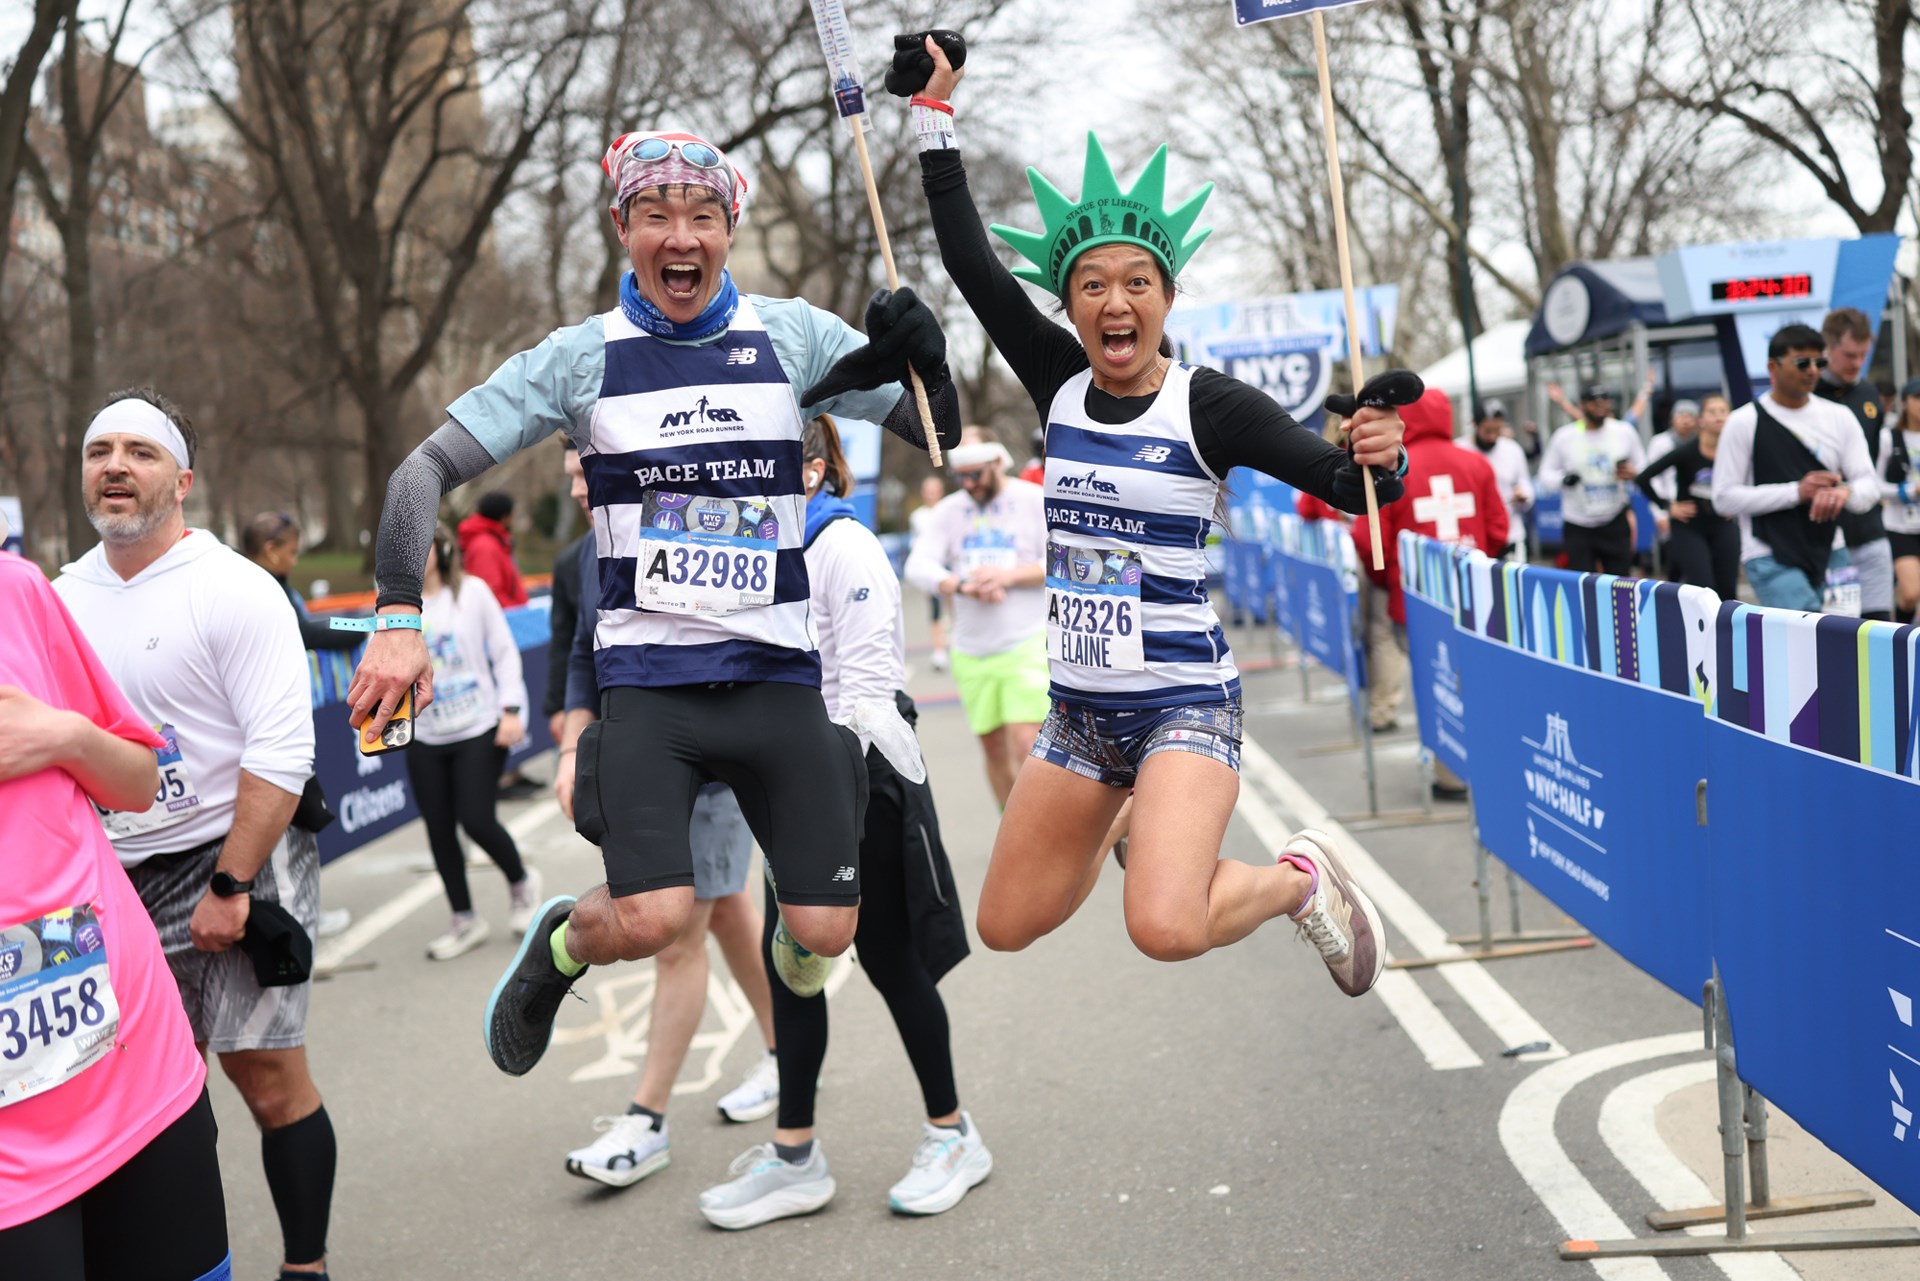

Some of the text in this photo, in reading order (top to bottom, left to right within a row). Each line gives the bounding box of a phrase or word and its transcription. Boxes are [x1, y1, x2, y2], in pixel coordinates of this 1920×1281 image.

[1065, 198, 1150, 222] STATUE OF LIBERTY
[623, 298, 652, 324] UNITED
[1233, 353, 1311, 389] NYC
[660, 431, 676, 439] NEW
[677, 429, 695, 437] YORK
[634, 459, 776, 487] PACE TEAM
[1096, 493, 1120, 502] RUNNERS
[703, 514, 721, 522] NYC
[1047, 507, 1146, 535] PACE TEAM
[646, 547, 768, 592] A32988
[742, 596, 764, 605] WAVE
[1048, 594, 1133, 637] A32326
[1062, 631, 1112, 668] ELAINE
[168, 800, 190, 811] WAVE
[340, 780, 406, 833] Citizens
[78, 1027, 111, 1050] WAVE
